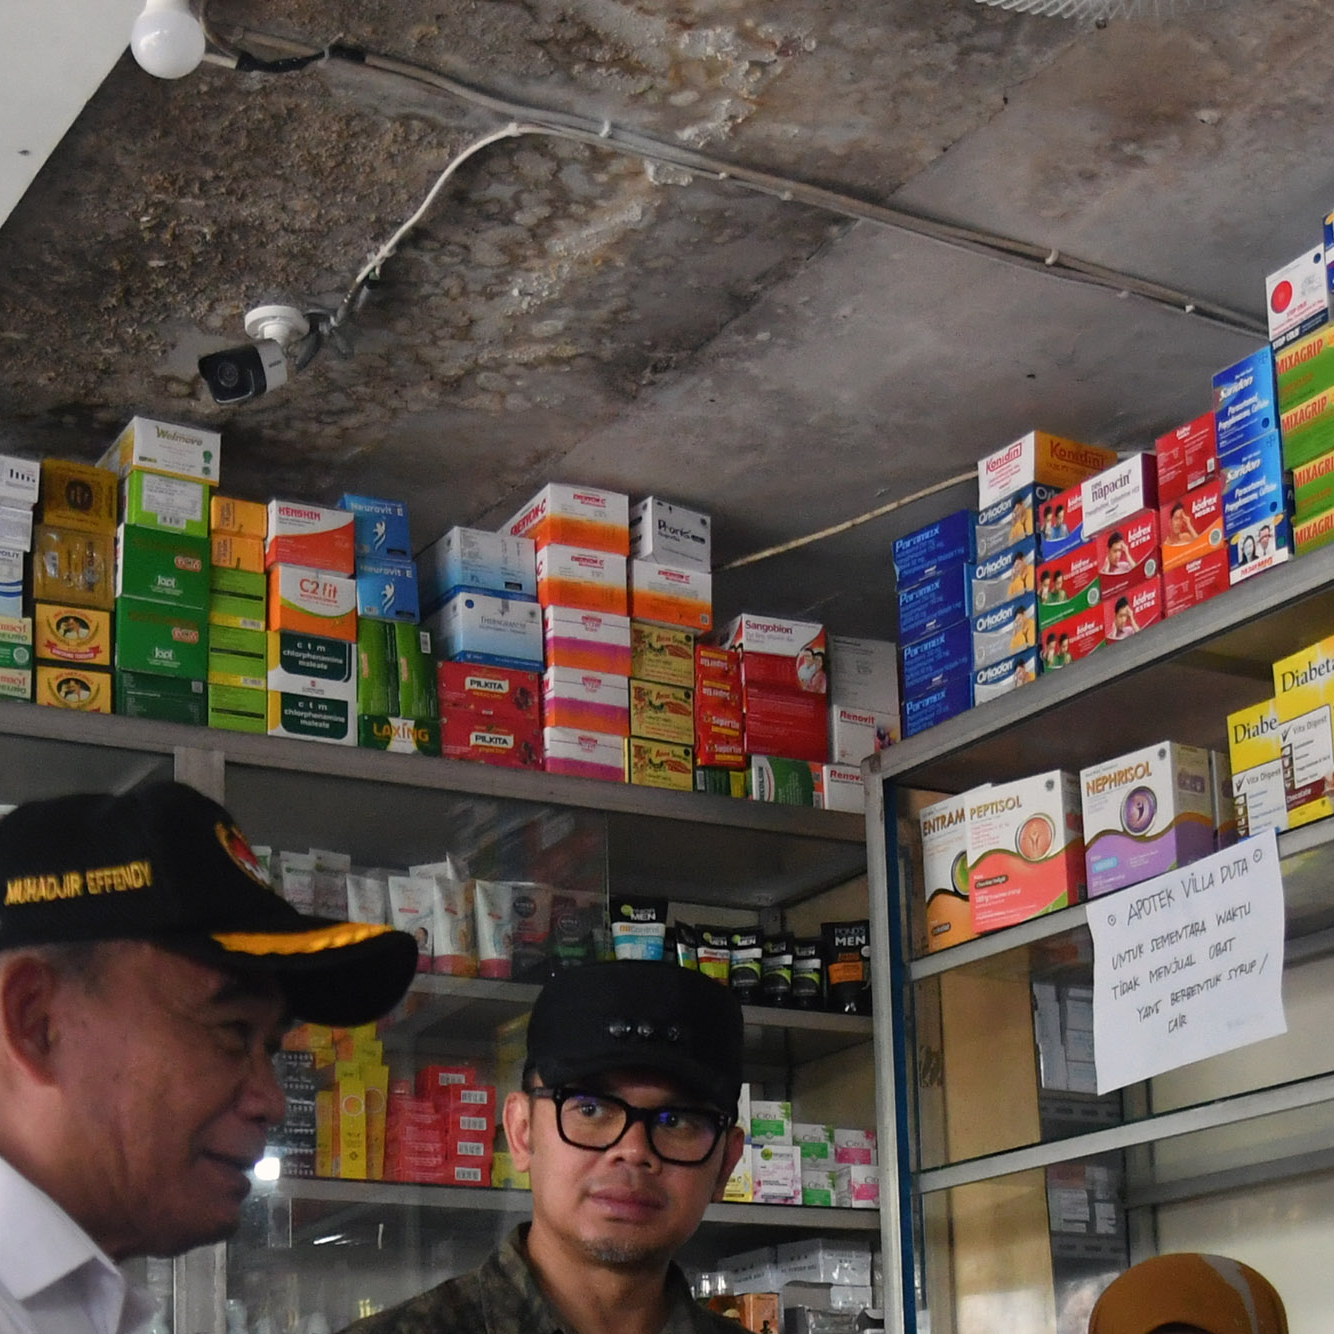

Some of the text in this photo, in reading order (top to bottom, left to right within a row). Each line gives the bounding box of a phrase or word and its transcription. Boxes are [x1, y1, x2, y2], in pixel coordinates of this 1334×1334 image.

[1276, 338, 1324, 375] MIXAGRIP
[1281, 396, 1328, 434] MIXAGRIP
[985, 442, 1022, 475] Konidin
[299, 577, 320, 594] C2
[745, 619, 793, 635] Sangobion
[469, 679, 504, 692] PILKITA
[840, 710, 875, 725] Renovit
[474, 734, 510, 747] PILKITA
[1086, 761, 1152, 797] NEPHRISOL
[969, 795, 1022, 821] PEPTISOL
[4, 861, 152, 906] MUHADJIR EFFENDY
[1127, 857, 1249, 926] APOTEK VILLA DUTA
[834, 936, 866, 947] MEN
[1112, 902, 1251, 970] UNTUK SEMENTARA WAKTU
[1112, 937, 1236, 1000] TIDAK MENJUAL OBAT
[1170, 974, 1222, 1007] BERBENTUK
[1168, 1014, 1187, 1034] CAIR
